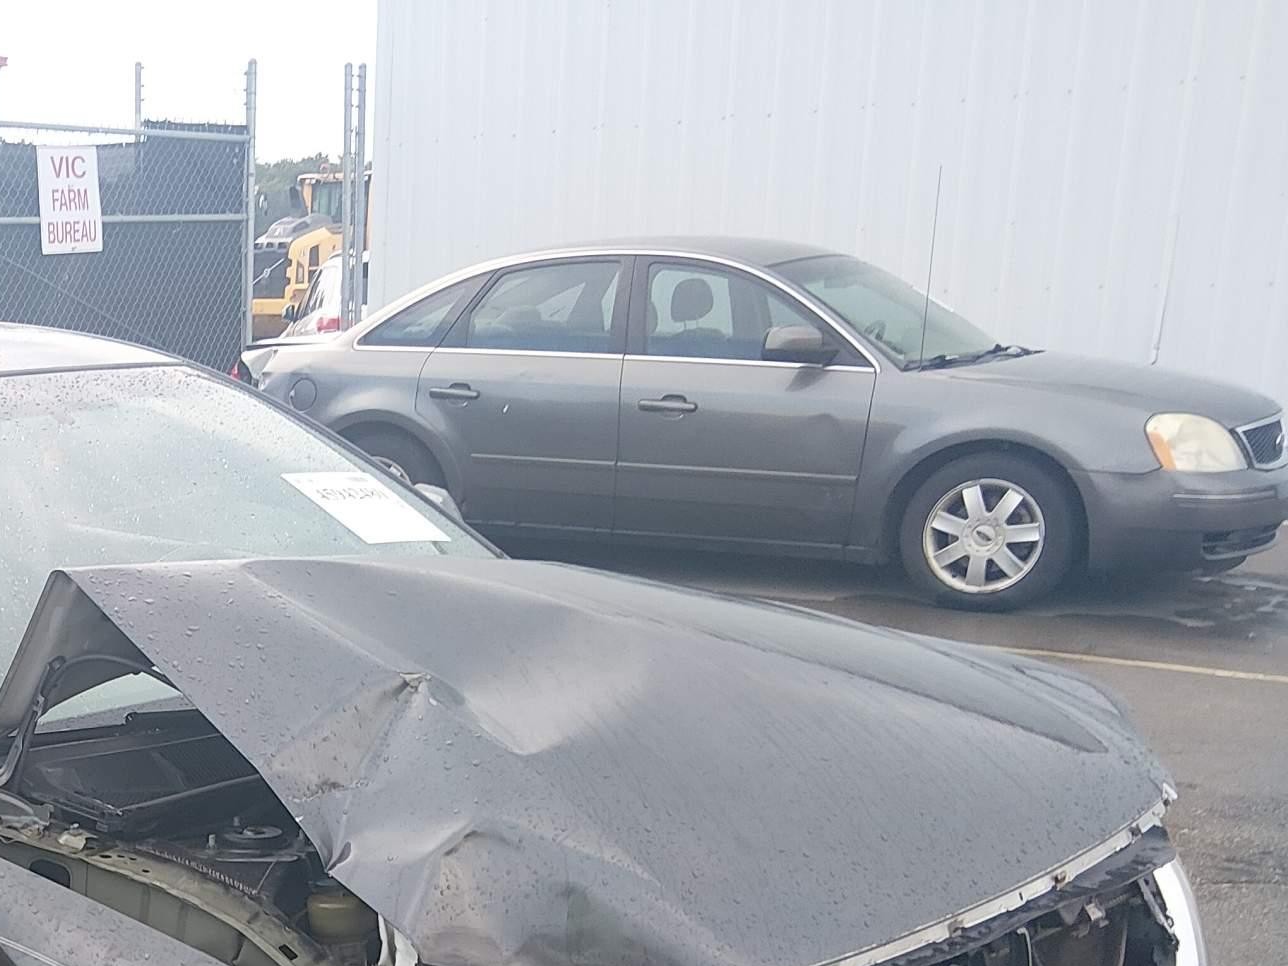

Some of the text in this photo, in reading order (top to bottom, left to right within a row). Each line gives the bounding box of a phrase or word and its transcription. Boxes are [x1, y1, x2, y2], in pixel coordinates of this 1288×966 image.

[50, 155, 87, 179] VIC
[51, 187, 89, 212] FARM
[47, 219, 97, 244] BUREAU
